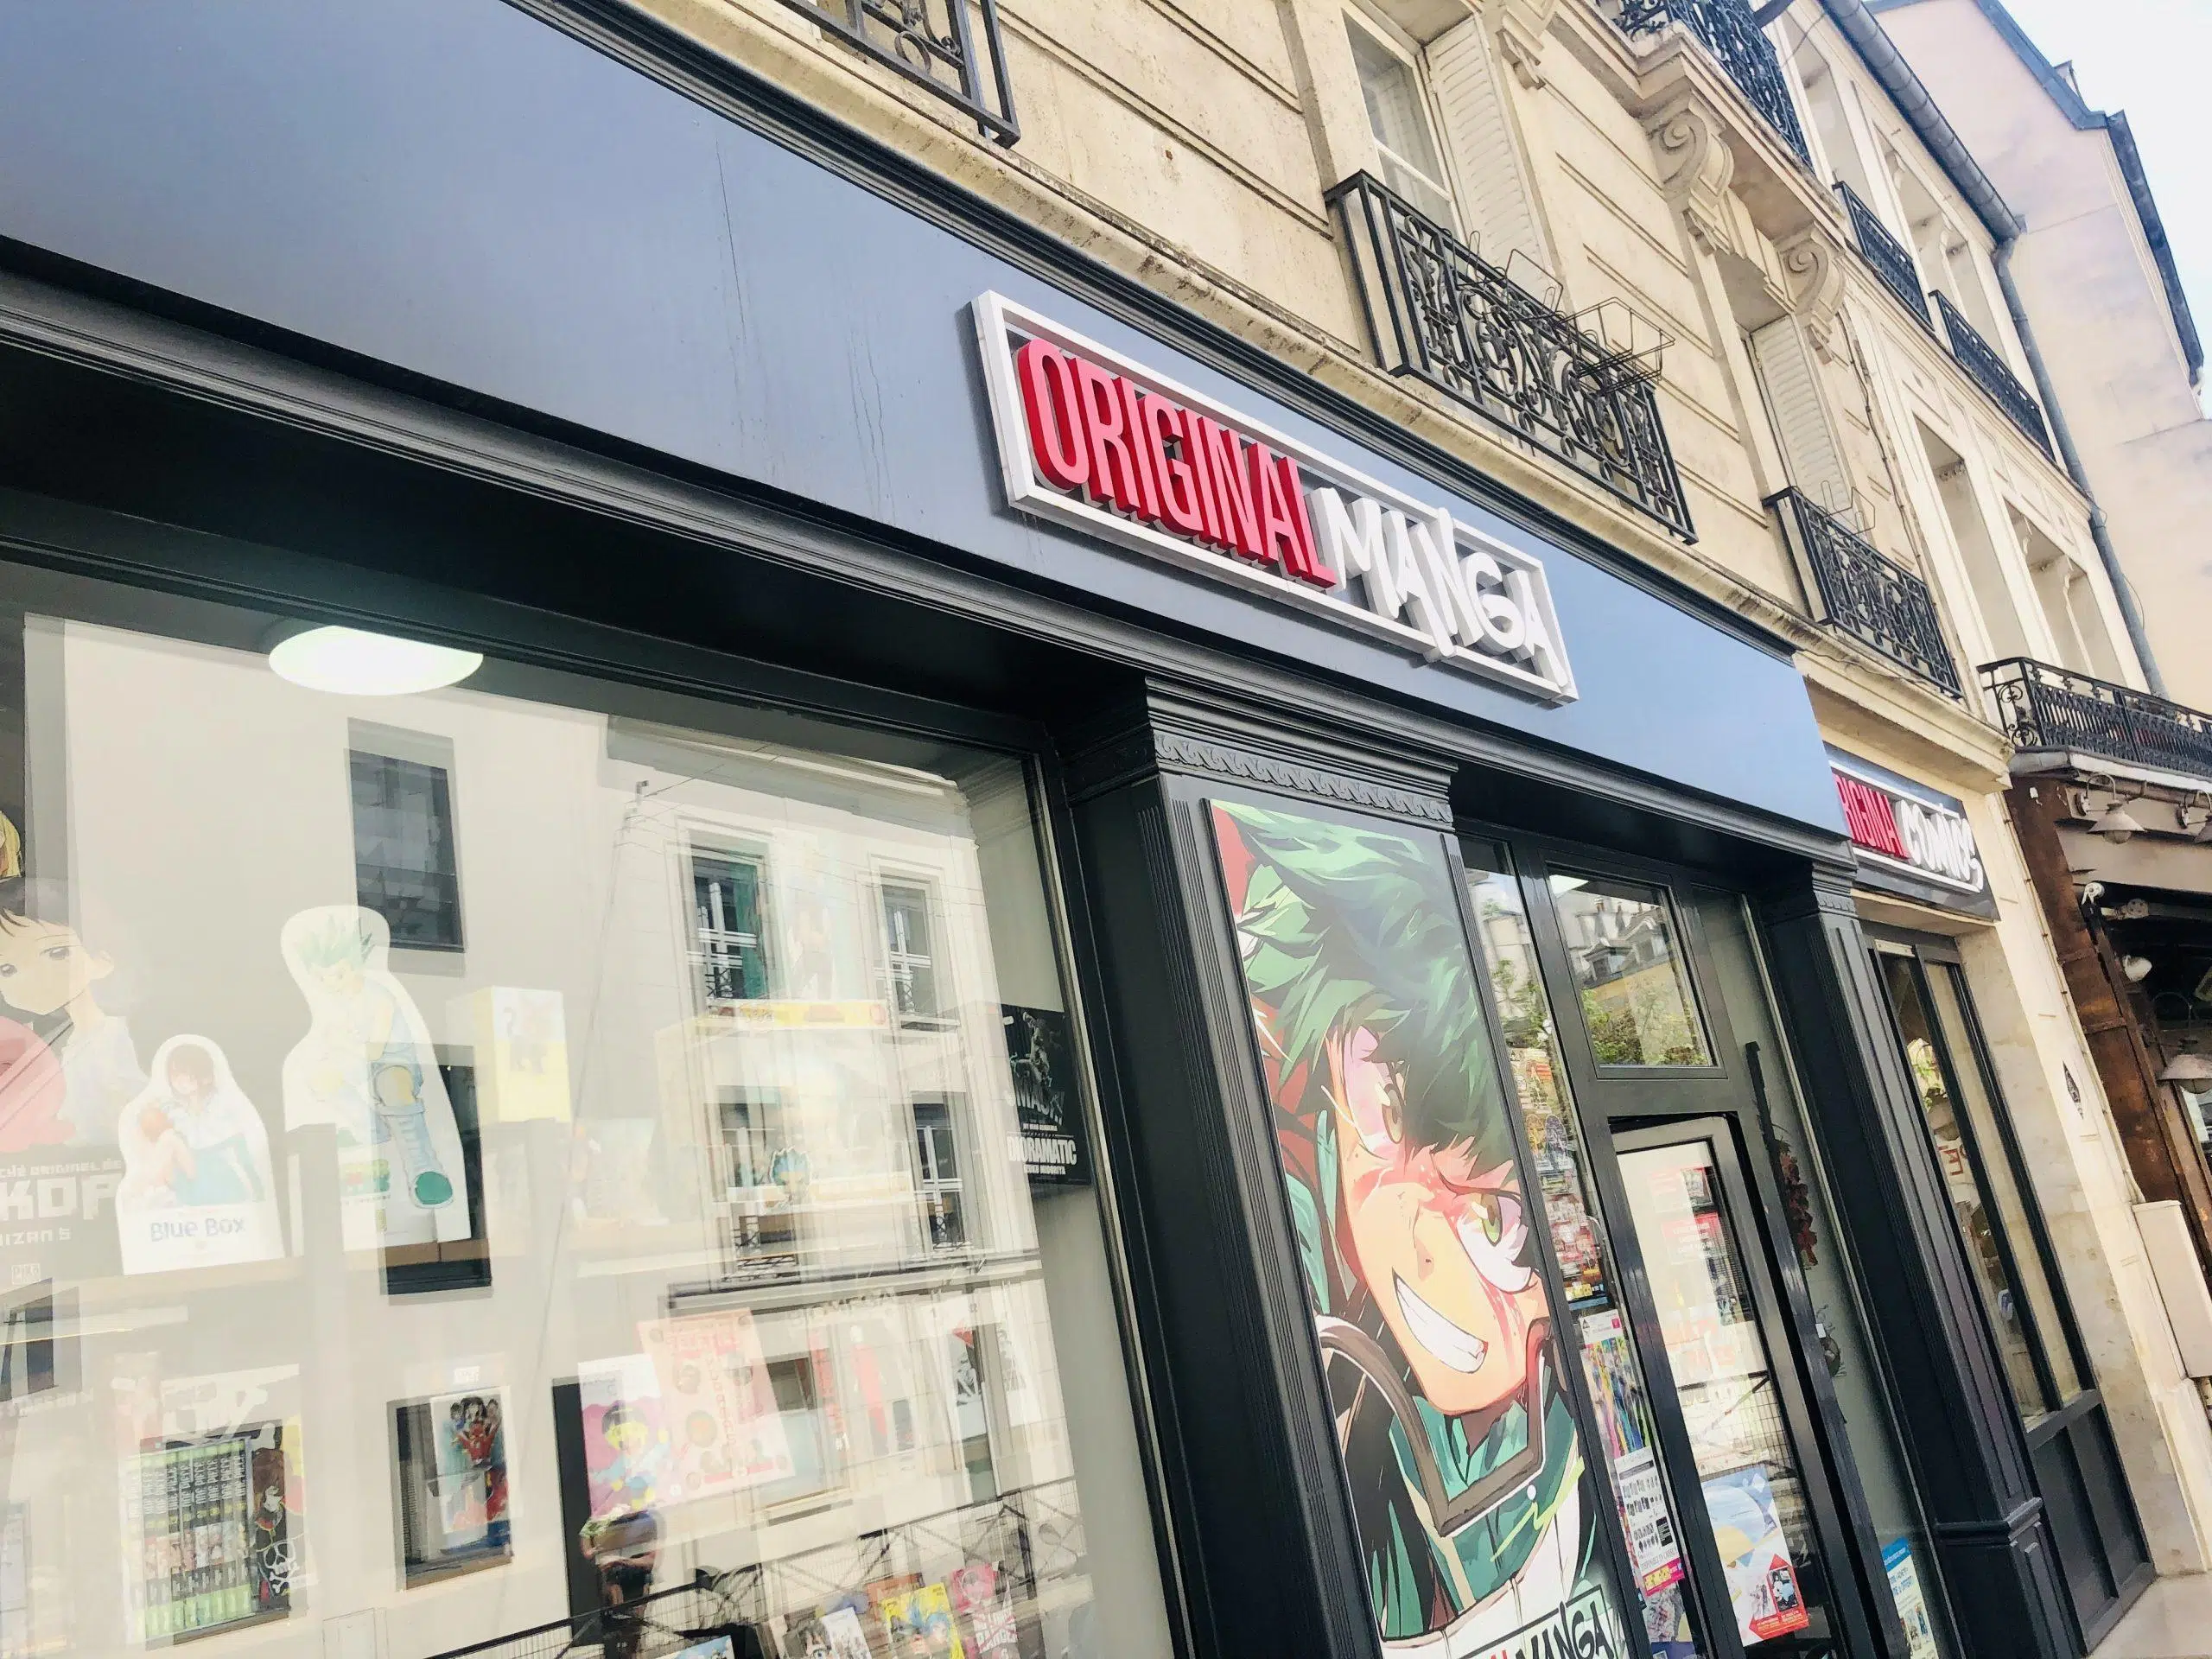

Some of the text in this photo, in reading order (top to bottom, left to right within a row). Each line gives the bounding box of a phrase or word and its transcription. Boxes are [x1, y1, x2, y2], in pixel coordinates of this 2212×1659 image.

[1014, 339, 1568, 689] ORIGINAL MANGA
[1896, 799, 1984, 890] COMICS
[1007, 1136, 1077, 1166] DIORAMATIC
[149, 1216, 245, 1242] Blue Box
